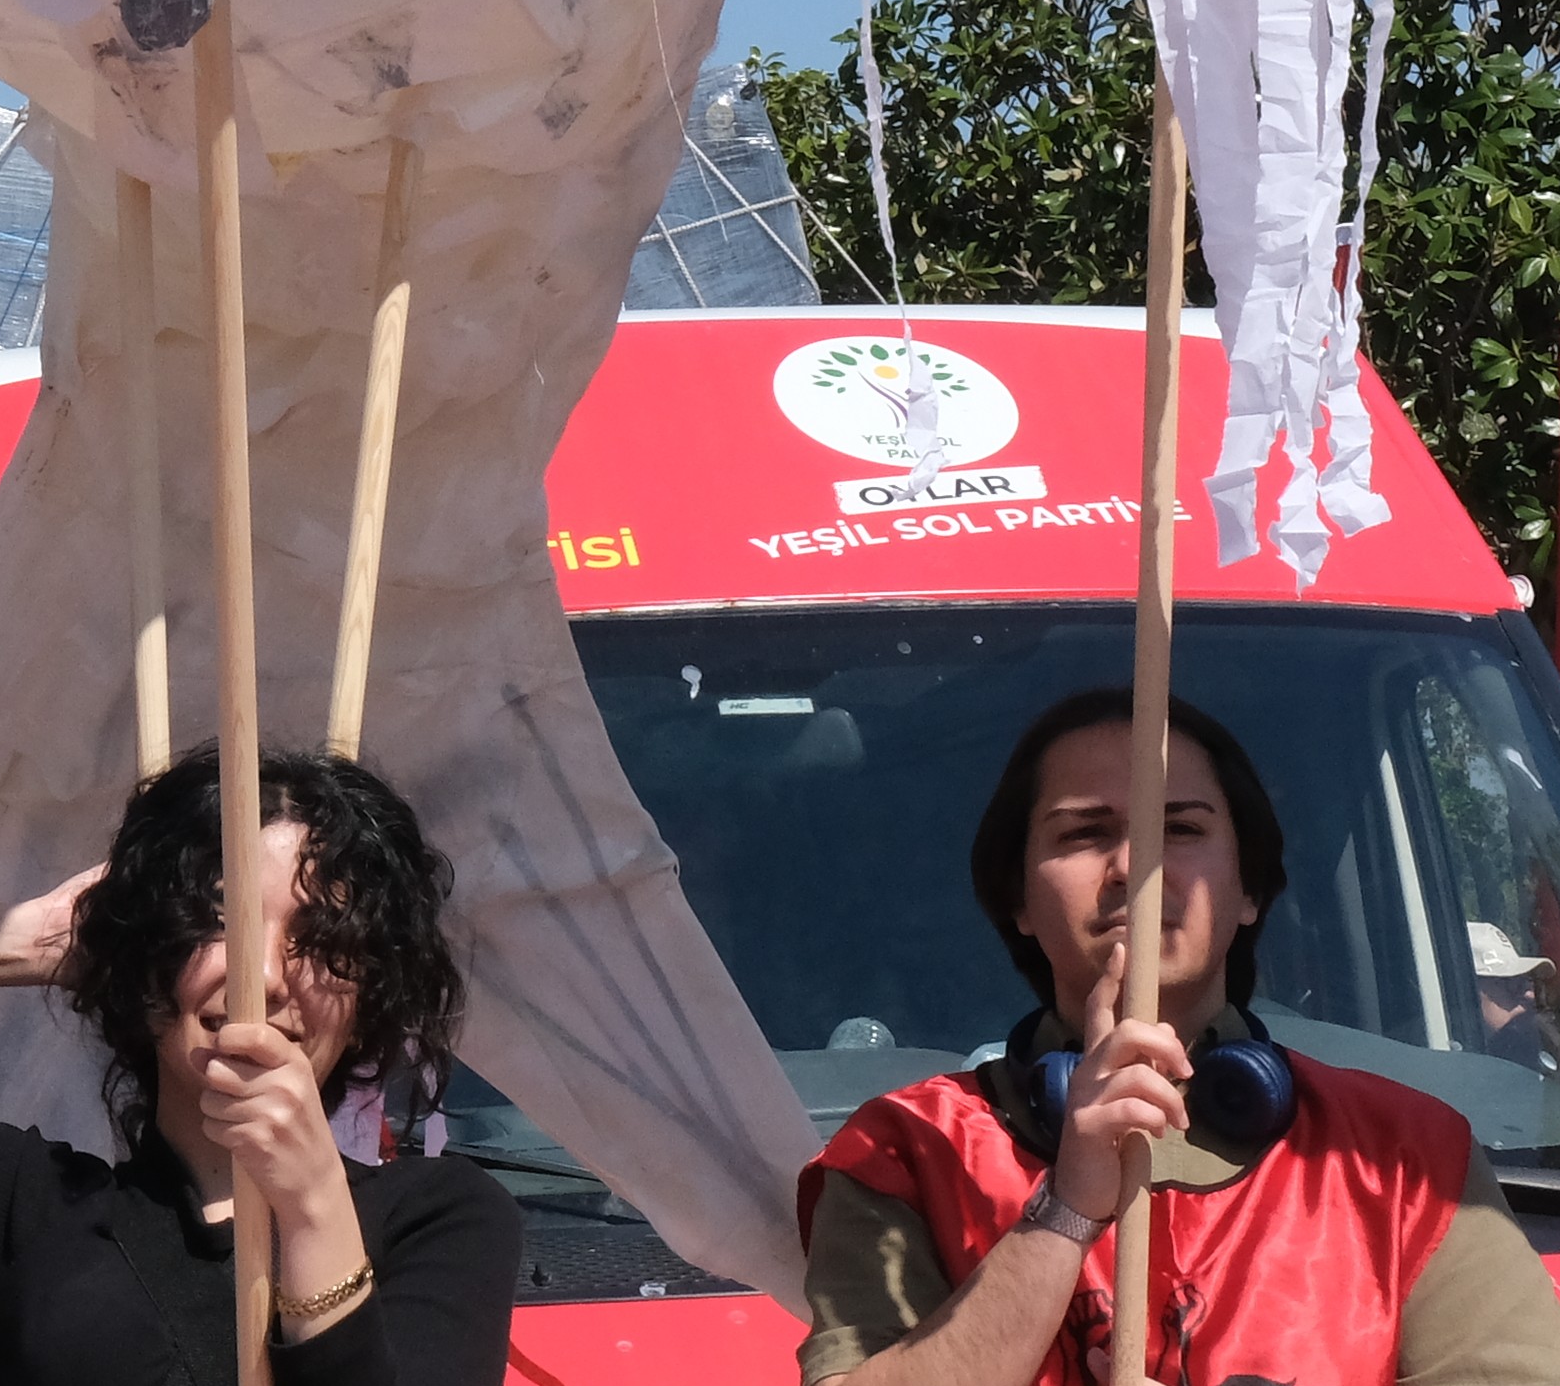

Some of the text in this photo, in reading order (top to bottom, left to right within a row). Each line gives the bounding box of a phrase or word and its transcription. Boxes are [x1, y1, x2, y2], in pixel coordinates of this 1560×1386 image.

[861, 433, 961, 447] YEŞİ OL
[547, 527, 640, 570] İSİ
[749, 518, 889, 559] YEŞİL
[889, 513, 993, 541] SOL
